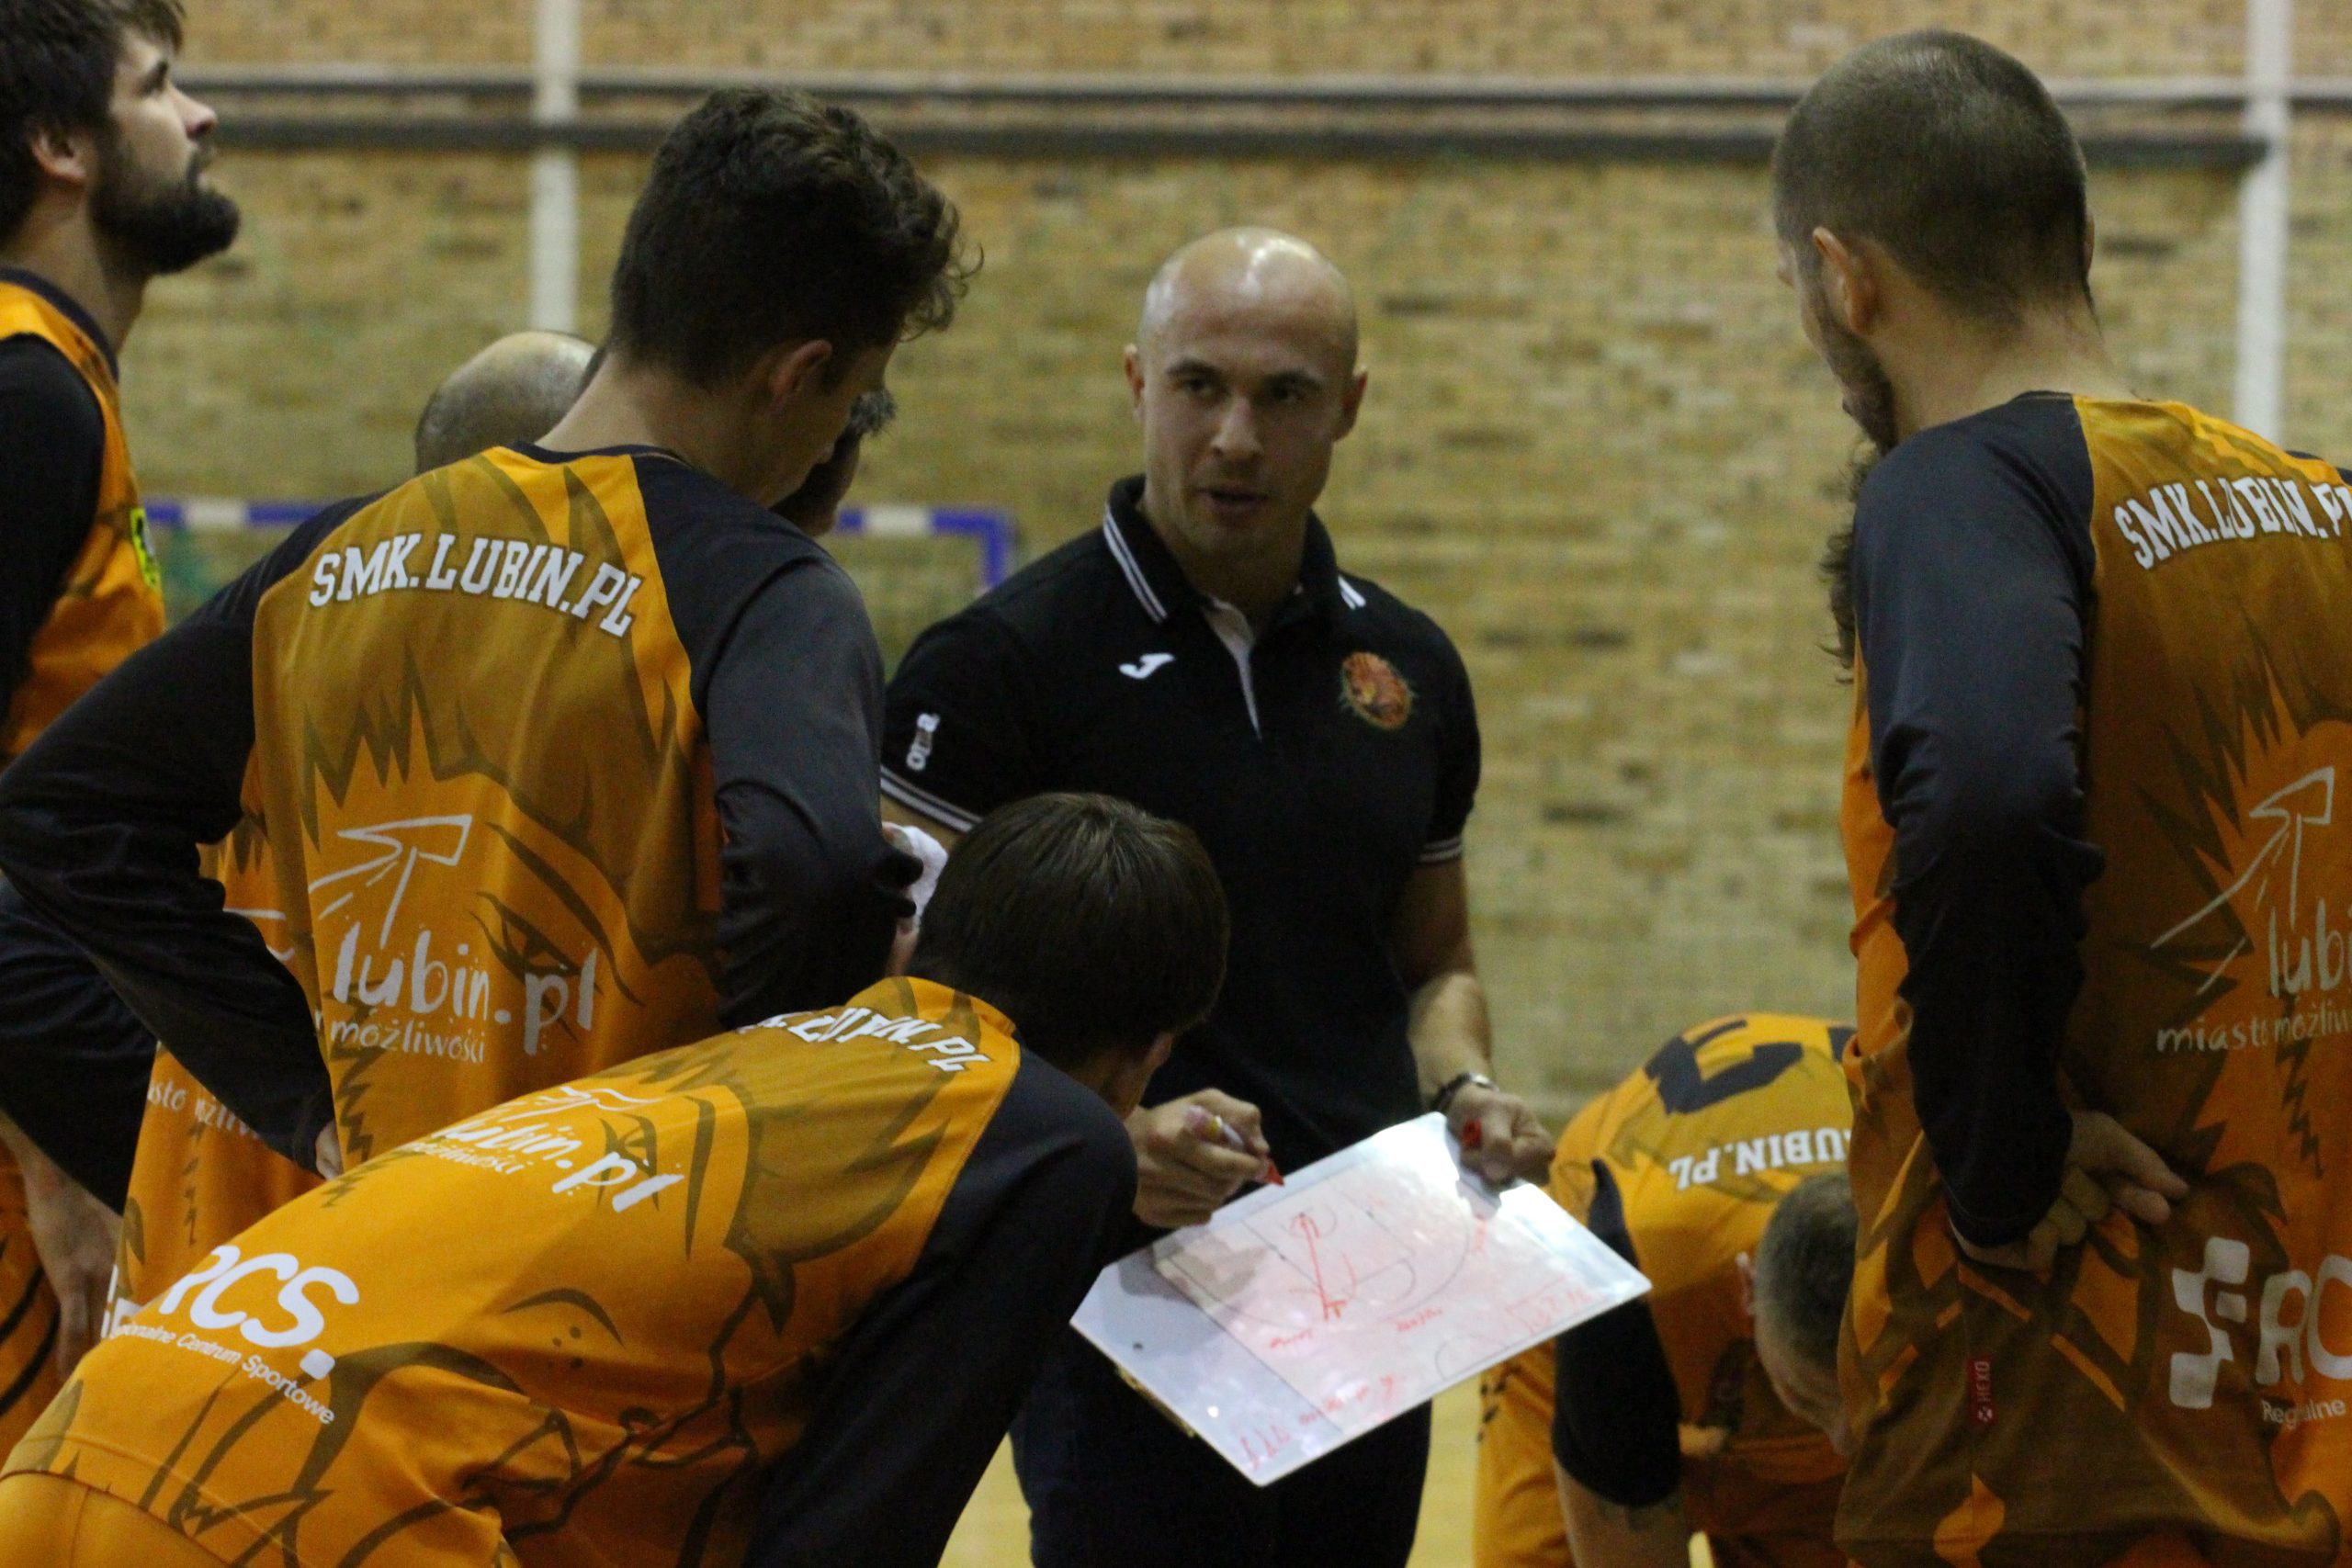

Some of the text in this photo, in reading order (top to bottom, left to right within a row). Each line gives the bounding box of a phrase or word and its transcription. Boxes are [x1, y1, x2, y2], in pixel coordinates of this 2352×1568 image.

[309, 533, 643, 638] SMK.LUBIN.PL
[333, 920, 598, 1056] lubin.pl
[1668, 1127, 1851, 1191] UBIN.PL
[176, 1332, 243, 1365] Centrum
[242, 1354, 335, 1425] Sportowe
